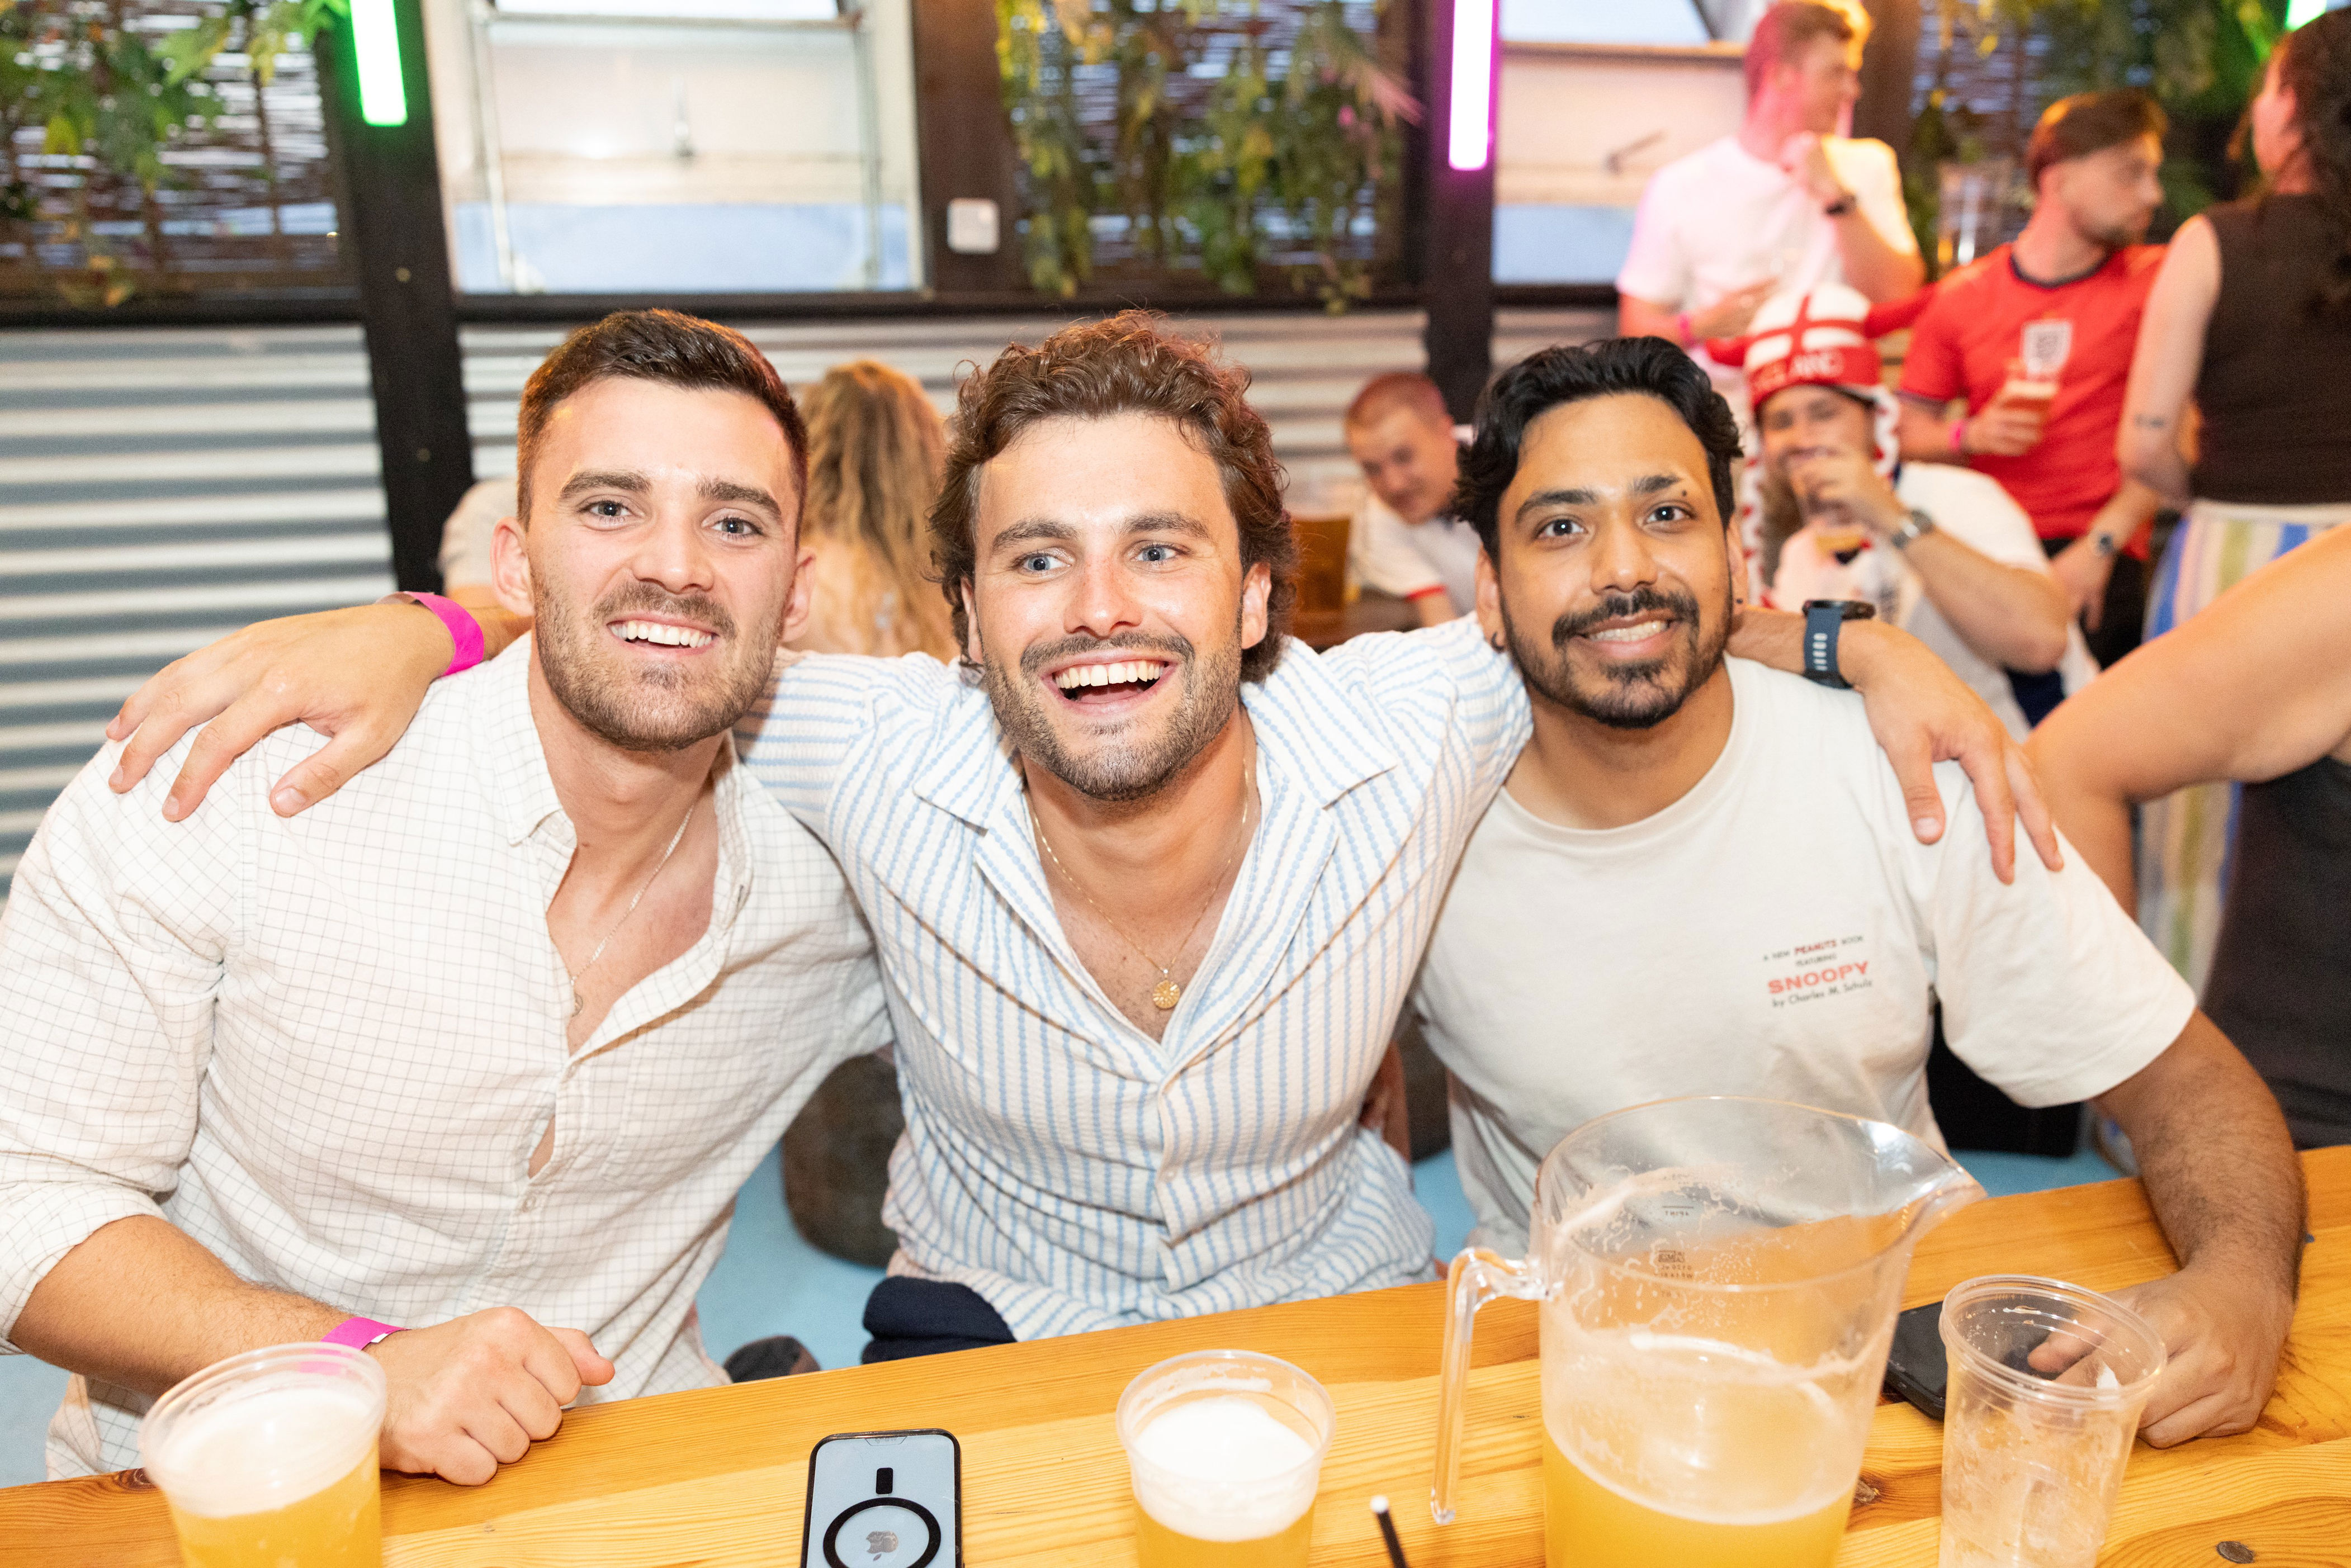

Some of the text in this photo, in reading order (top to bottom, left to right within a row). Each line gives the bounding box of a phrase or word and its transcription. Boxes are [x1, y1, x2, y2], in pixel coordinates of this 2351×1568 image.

[1794, 939, 1837, 955] PEANUTS
[1842, 935, 1863, 945] BOOK
[1768, 961, 1868, 994] SNOOPY
[1772, 998, 1785, 1007] by
[1789, 989, 1824, 1005] Charles
[1843, 978, 1873, 992] Schulz
